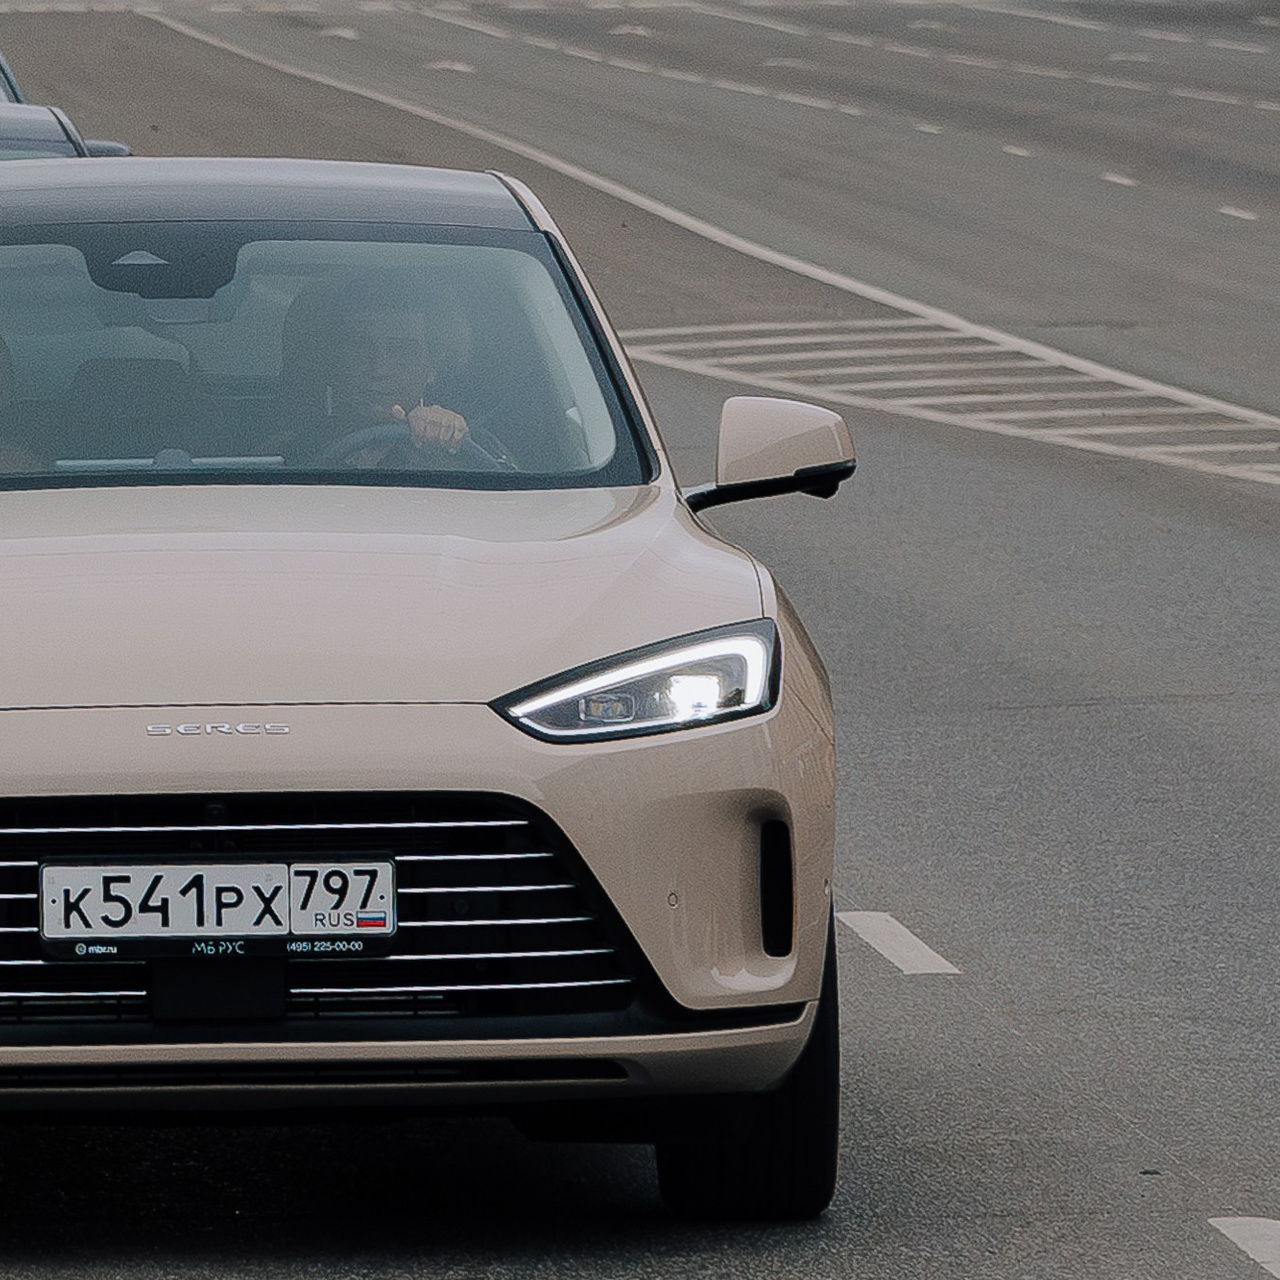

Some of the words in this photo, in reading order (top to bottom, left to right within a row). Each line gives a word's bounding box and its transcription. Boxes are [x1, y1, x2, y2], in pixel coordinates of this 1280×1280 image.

[146, 723, 290, 736] SERES
[293, 869, 379, 911] 797
[314, 912, 354, 928] RUS
[286, 941, 312, 952] (495)
[313, 940, 363, 951] 225-00-00
